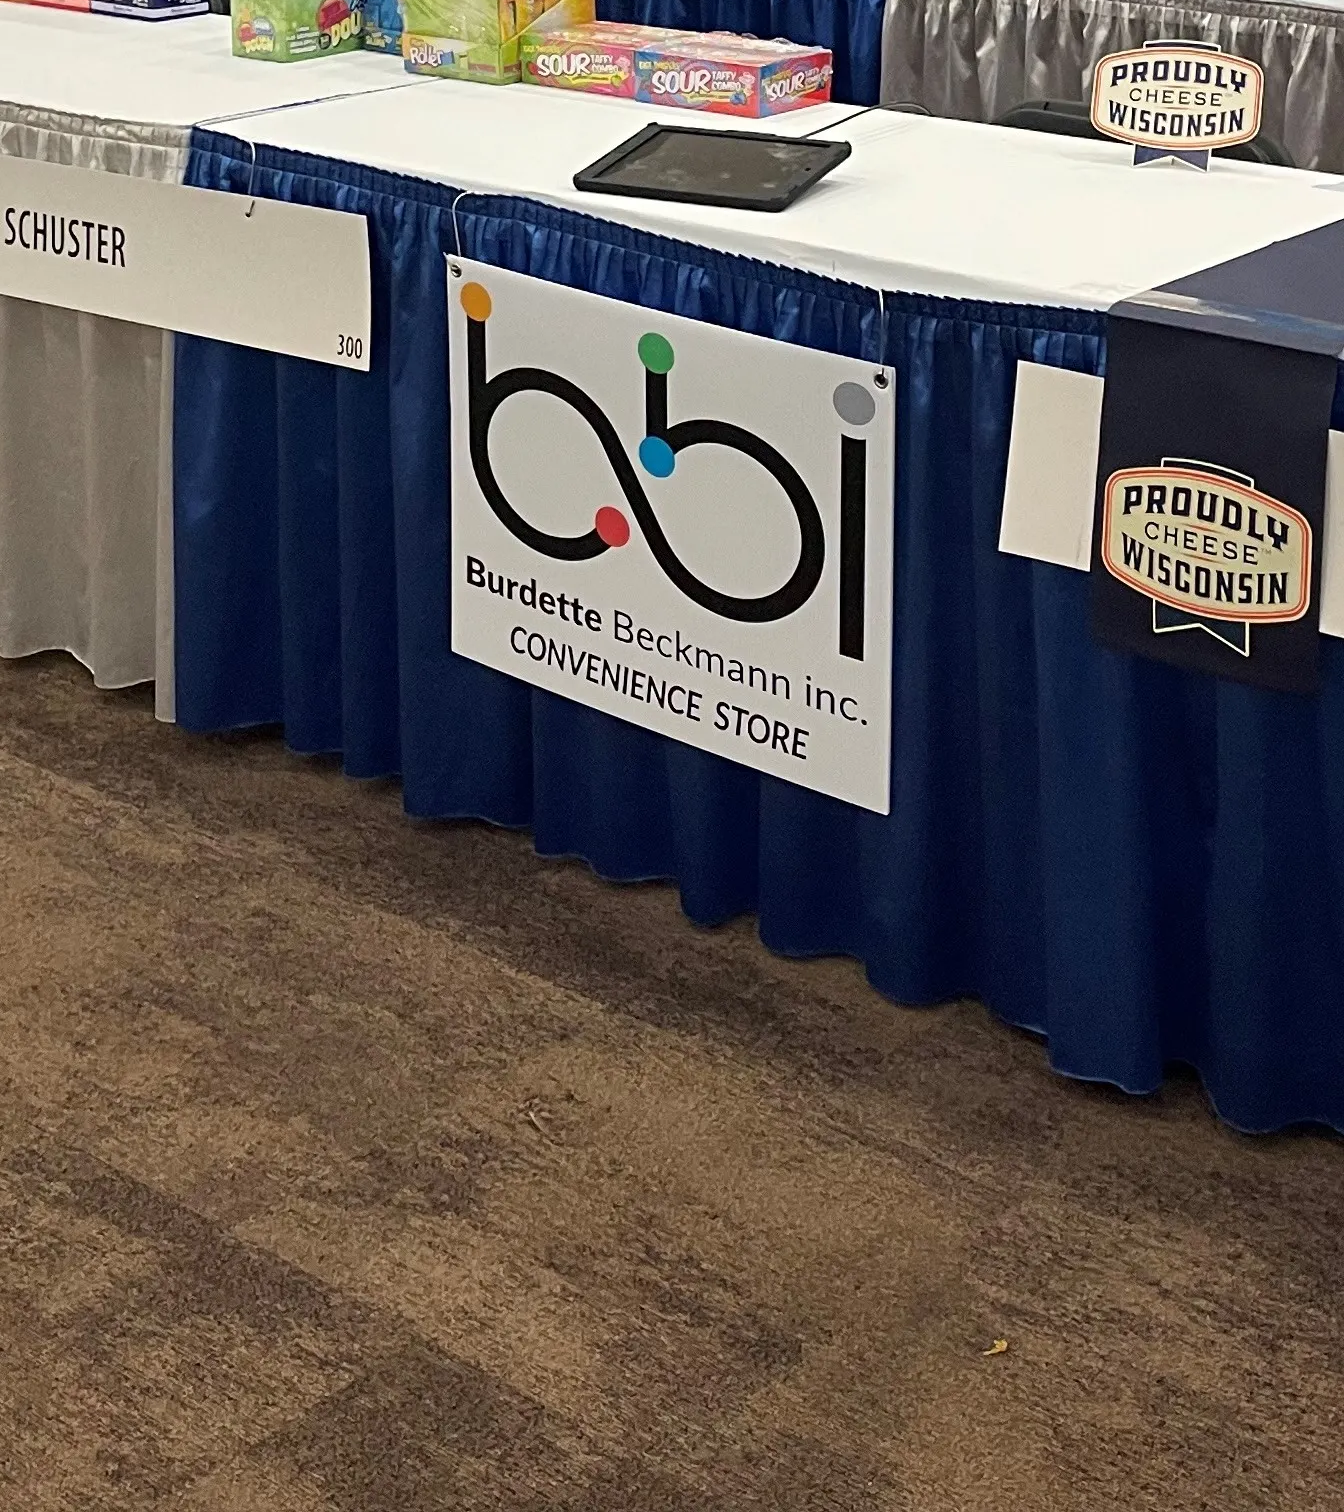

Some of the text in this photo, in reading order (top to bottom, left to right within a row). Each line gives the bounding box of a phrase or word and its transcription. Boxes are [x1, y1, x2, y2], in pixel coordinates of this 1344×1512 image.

[537, 53, 614, 78] SOUR TAFFY
[651, 69, 736, 95] SOUR TAFFY
[1110, 59, 1248, 94] PROUDLY
[712, 80, 742, 91] COMBO
[765, 69, 805, 102] SOUR
[1128, 88, 1223, 107] CHEESE
[1108, 100, 1246, 138] WISCONSIN
[4, 207, 126, 268] SCHUSTER
[336, 333, 363, 360] 300
[1122, 485, 1290, 552] PROUDLY
[1144, 521, 1259, 566] CHEESE
[1121, 531, 1289, 605] WISCONSIN
[465, 555, 868, 726] Burdette Beckmann inc.
[510, 626, 810, 761] CONVENIENCE STORE
